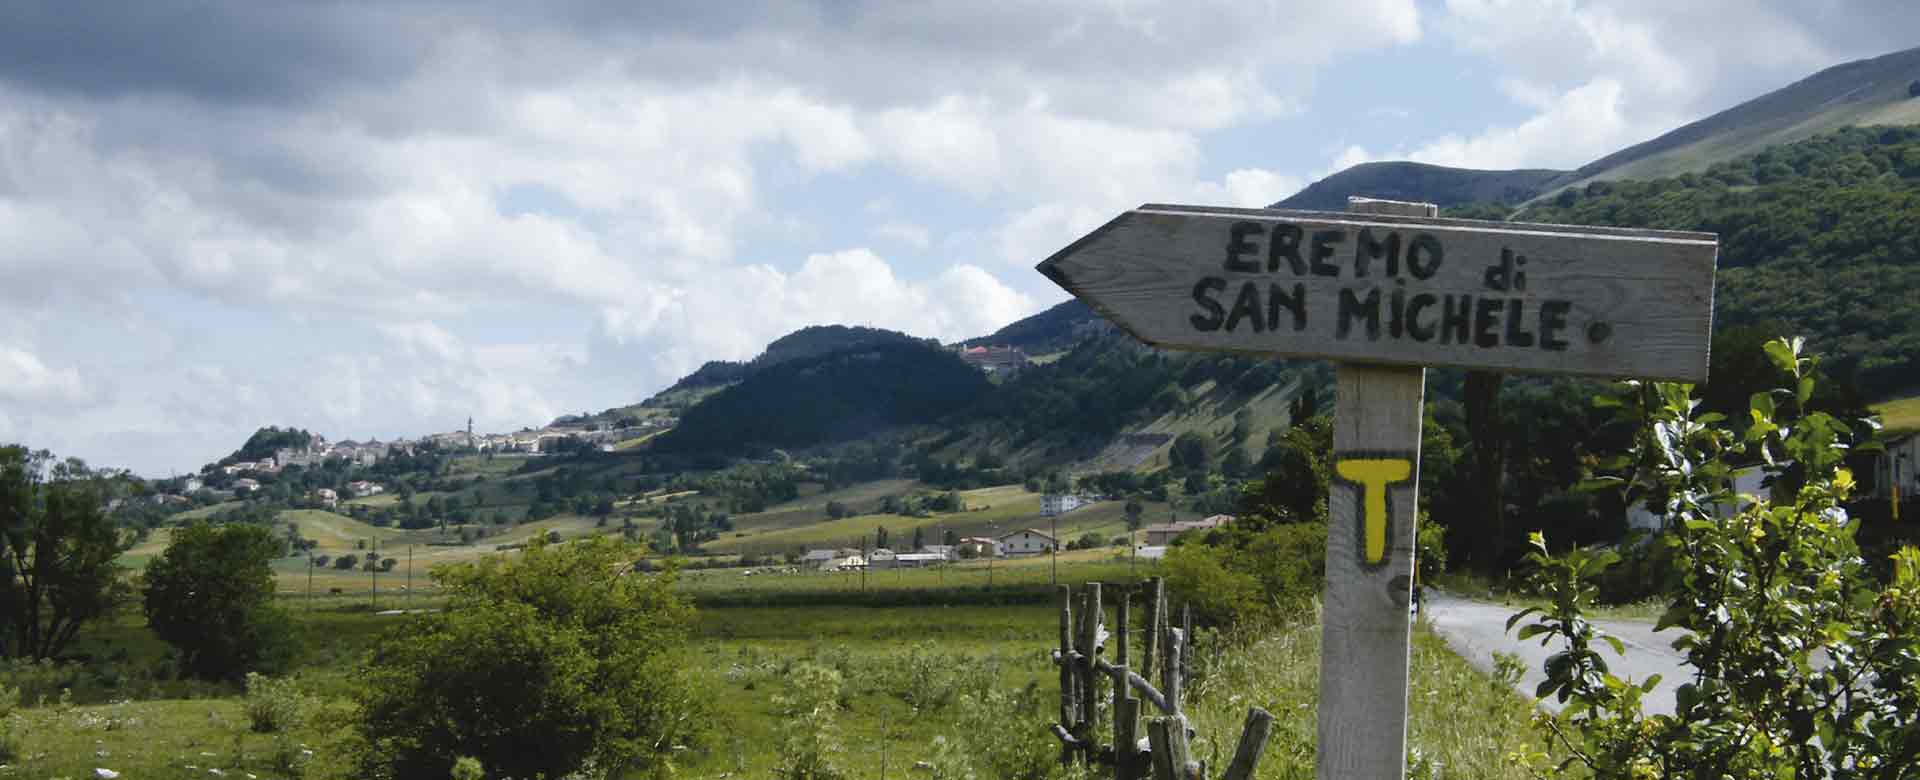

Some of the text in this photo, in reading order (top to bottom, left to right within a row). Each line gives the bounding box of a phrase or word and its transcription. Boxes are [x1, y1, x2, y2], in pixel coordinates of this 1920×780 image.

[1223, 221, 1527, 292] EREMO di
[1189, 276, 1308, 334] SAN
[1334, 455, 1413, 567] T
